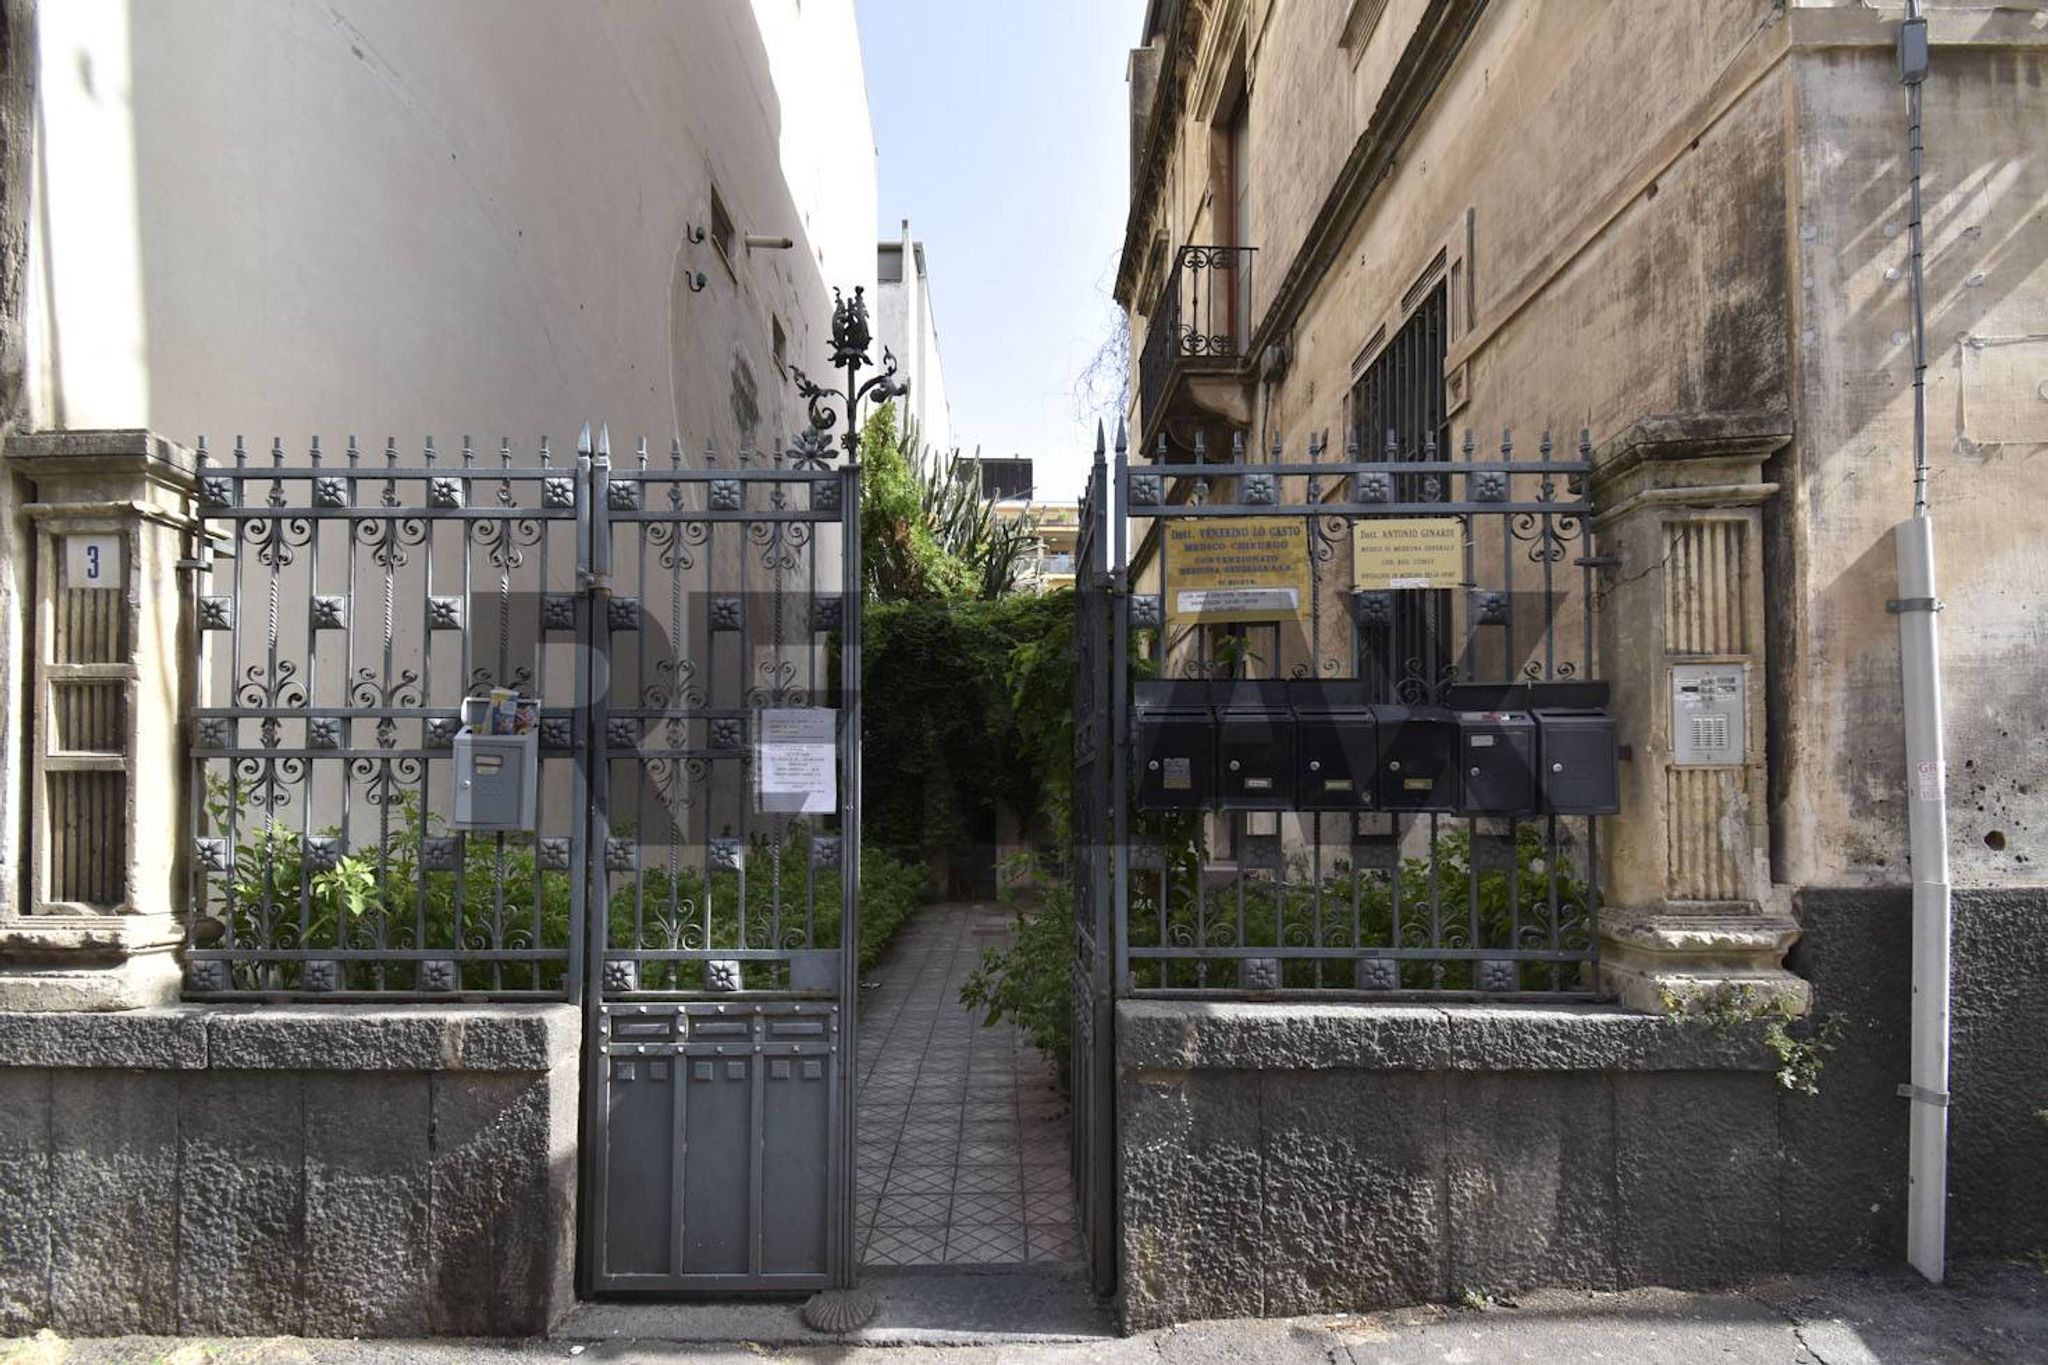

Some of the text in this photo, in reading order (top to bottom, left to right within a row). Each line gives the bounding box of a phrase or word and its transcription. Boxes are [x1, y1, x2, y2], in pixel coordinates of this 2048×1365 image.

[1382, 529, 1418, 538] ANTONIO
[1184, 541, 1289, 552] MEDICO CHIRURGO
[86, 545, 100, 579] 3
